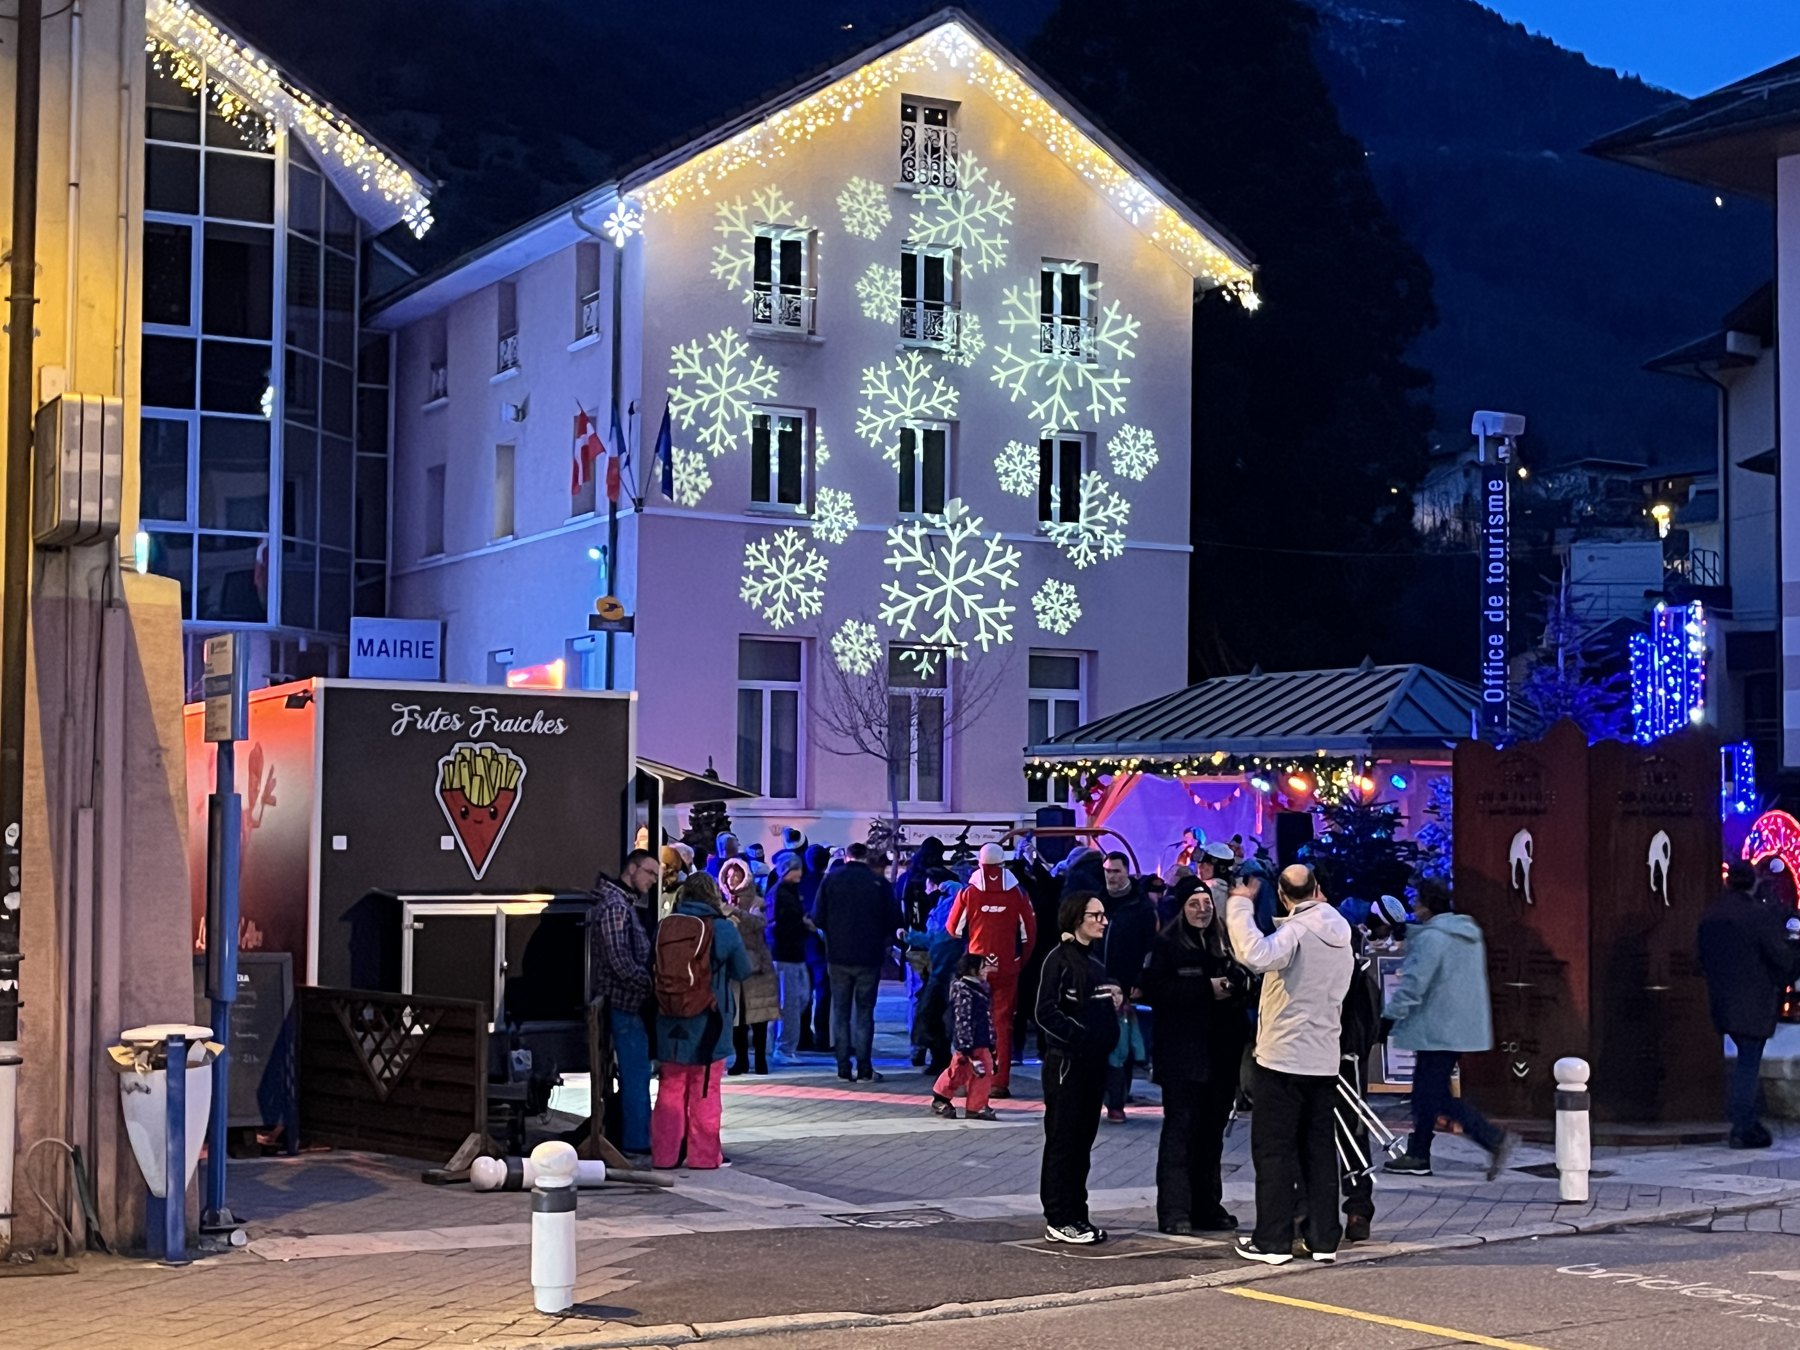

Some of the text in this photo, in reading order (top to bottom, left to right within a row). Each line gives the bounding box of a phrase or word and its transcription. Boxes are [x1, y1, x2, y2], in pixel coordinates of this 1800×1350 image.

[1483, 479, 1505, 584] tourisme
[1483, 595, 1505, 622] de
[357, 638, 435, 659] MAIRIE
[1483, 634, 1505, 703] Office
[391, 702, 568, 738] Frites Fraiches
